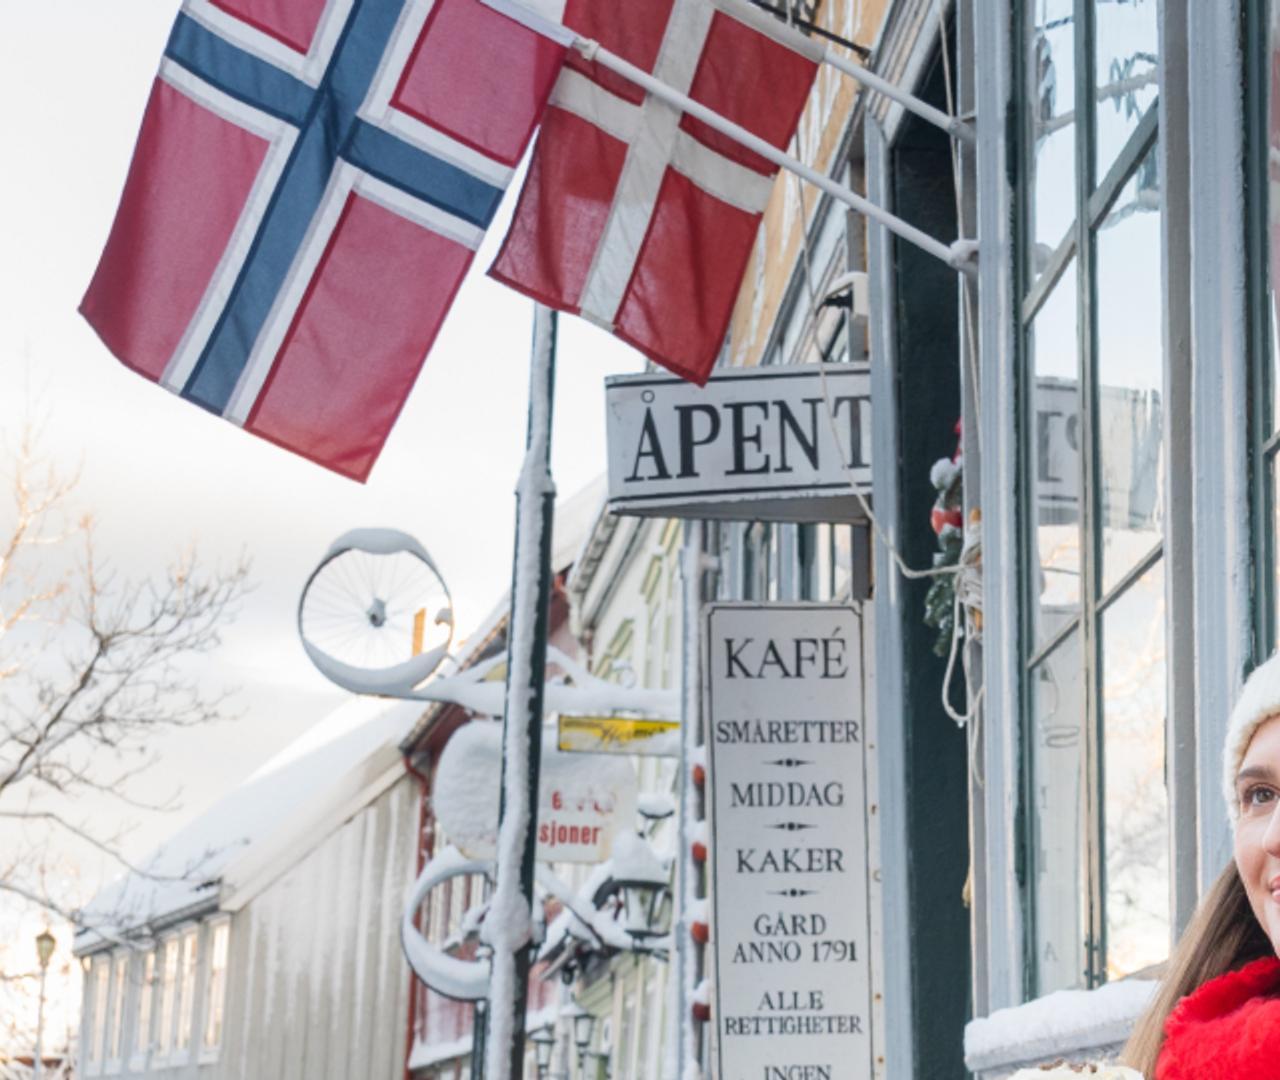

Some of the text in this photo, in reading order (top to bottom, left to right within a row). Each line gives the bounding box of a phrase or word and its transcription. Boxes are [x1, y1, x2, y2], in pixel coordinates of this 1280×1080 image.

[624, 390, 872, 482] ÅPENT
[724, 627, 849, 679] KAFÉ
[716, 718, 860, 744] SMÅRETTER
[730, 782, 845, 808] MIDDAG
[538, 824, 600, 848] sjoner
[736, 848, 845, 873] KAKER
[754, 911, 826, 936] GÅRD
[732, 939, 859, 964] ANNO 1791
[758, 990, 825, 1011] ALLE
[725, 1014, 863, 1036] RETTIGHETER
